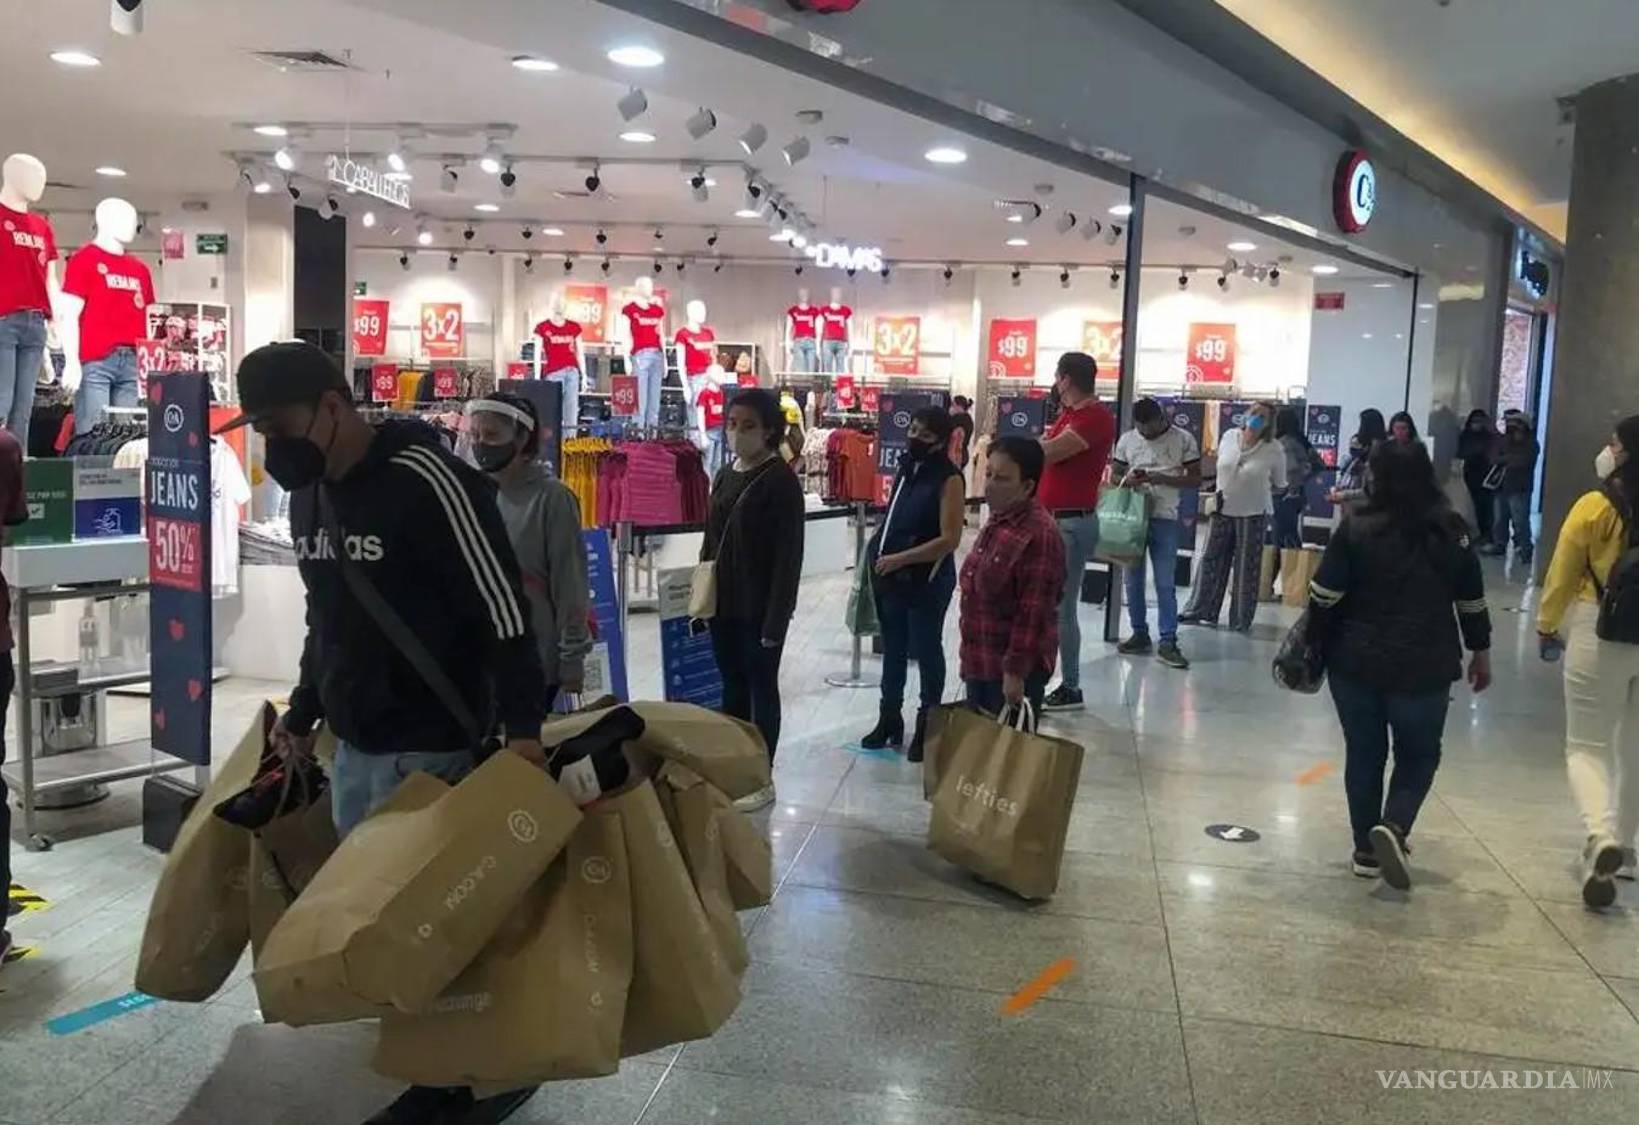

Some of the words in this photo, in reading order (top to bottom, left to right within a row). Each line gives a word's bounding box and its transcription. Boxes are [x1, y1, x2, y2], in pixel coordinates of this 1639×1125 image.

[998, 335, 1029, 358] $99
[1195, 339, 1227, 362] $99
[151, 471, 199, 511] JEANS
[155, 520, 195, 573] 50%
[955, 775, 1018, 816] lefties
